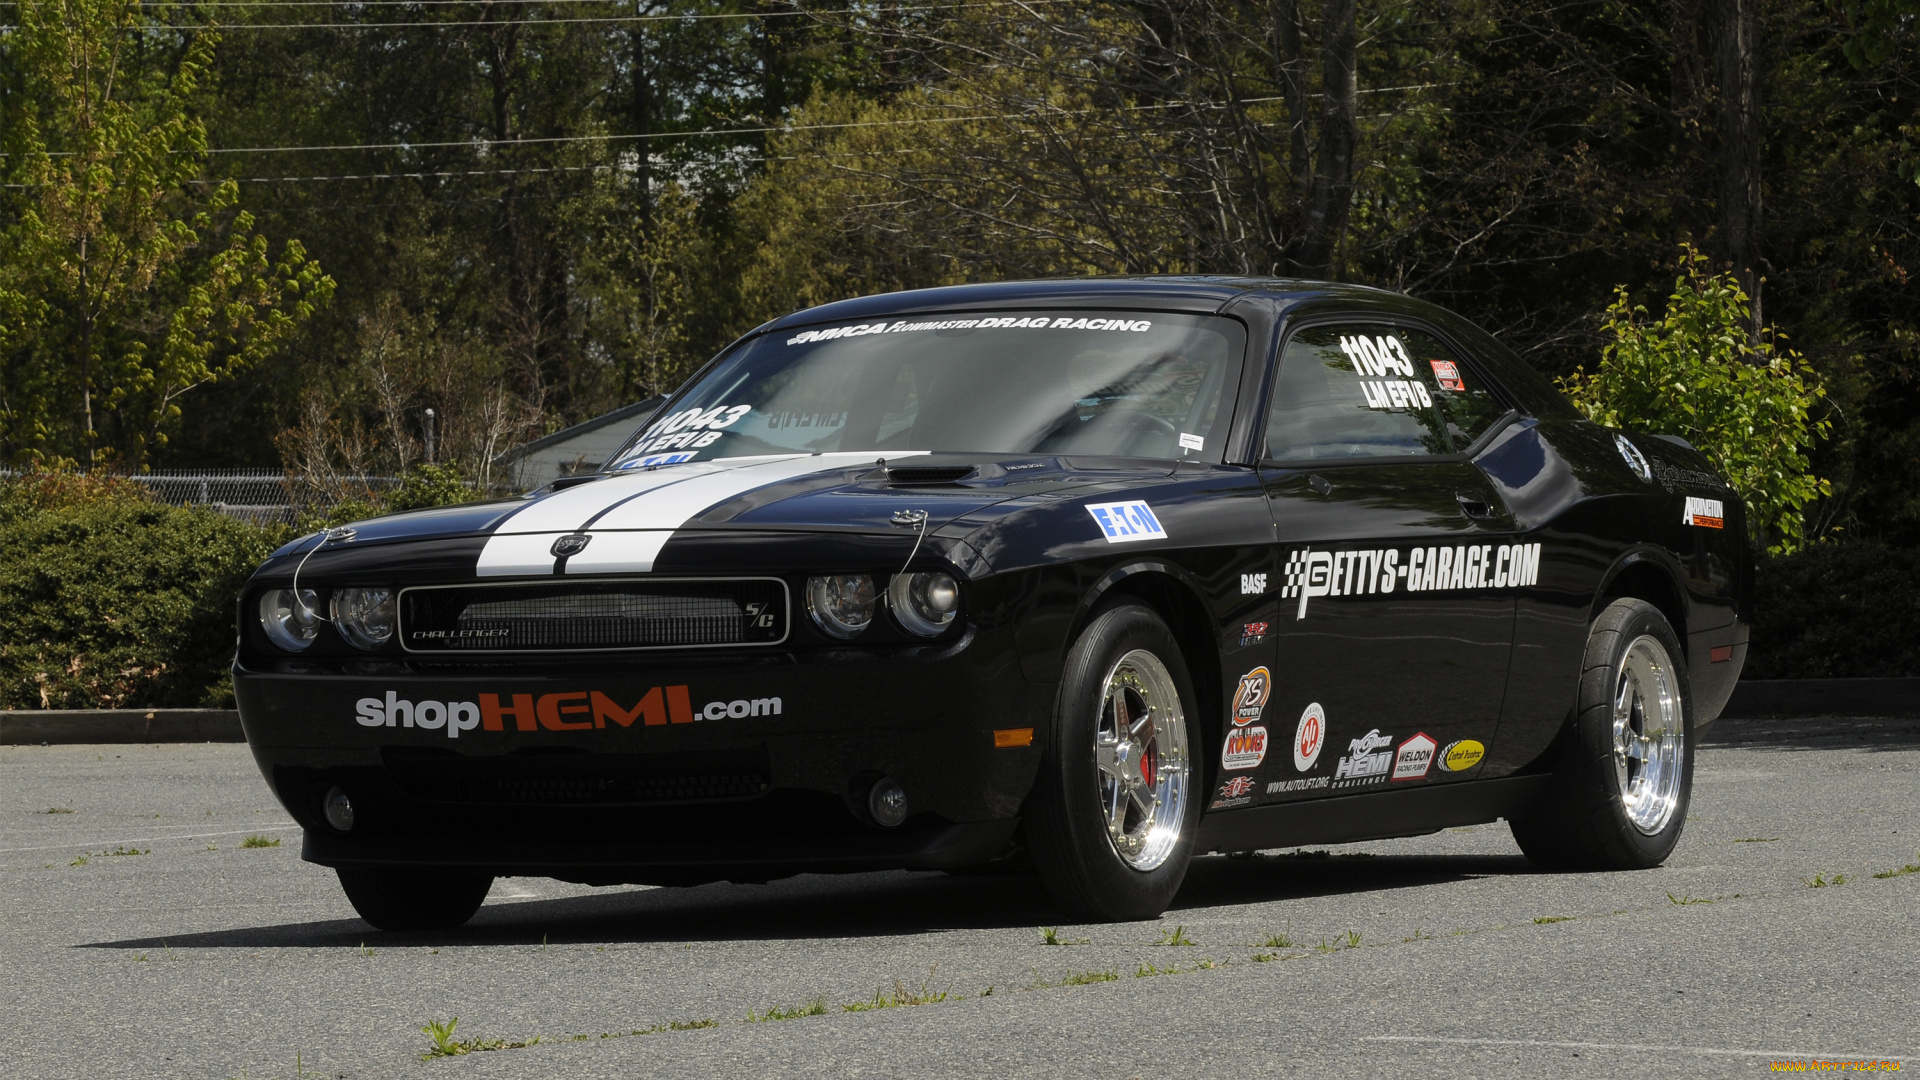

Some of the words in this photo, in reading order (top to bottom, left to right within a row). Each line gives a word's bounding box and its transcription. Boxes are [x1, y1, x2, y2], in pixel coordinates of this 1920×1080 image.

[799, 322, 888, 344] NMCA
[975, 317, 1050, 328] DRAG
[1049, 317, 1152, 332] RACING
[1340, 335, 1414, 377] 11043
[1360, 381, 1392, 408] LM
[1385, 381, 1432, 410] EFI/B
[636, 404, 752, 444] 11043
[645, 430, 723, 453] EFI/B
[1091, 504, 1162, 537] EATON
[1241, 573, 1267, 594] BASF
[745, 602, 774, 627] S/C
[413, 629, 509, 639] CHALLENGER
[1239, 677, 1263, 706] XS
[355, 685, 782, 738] shopHEMI.com
[1239, 707, 1260, 717] POWER
[1228, 735, 1265, 755] KOOKS
[1398, 749, 1433, 762] WELDON
[1334, 751, 1393, 780] HEMI
[1396, 764, 1413, 773] RACING
[1411, 763, 1428, 772] PUMPS
[1266, 776, 1330, 794] WWW.AUTOLIFT.ORG
[1332, 776, 1387, 789] CHALLENGE
